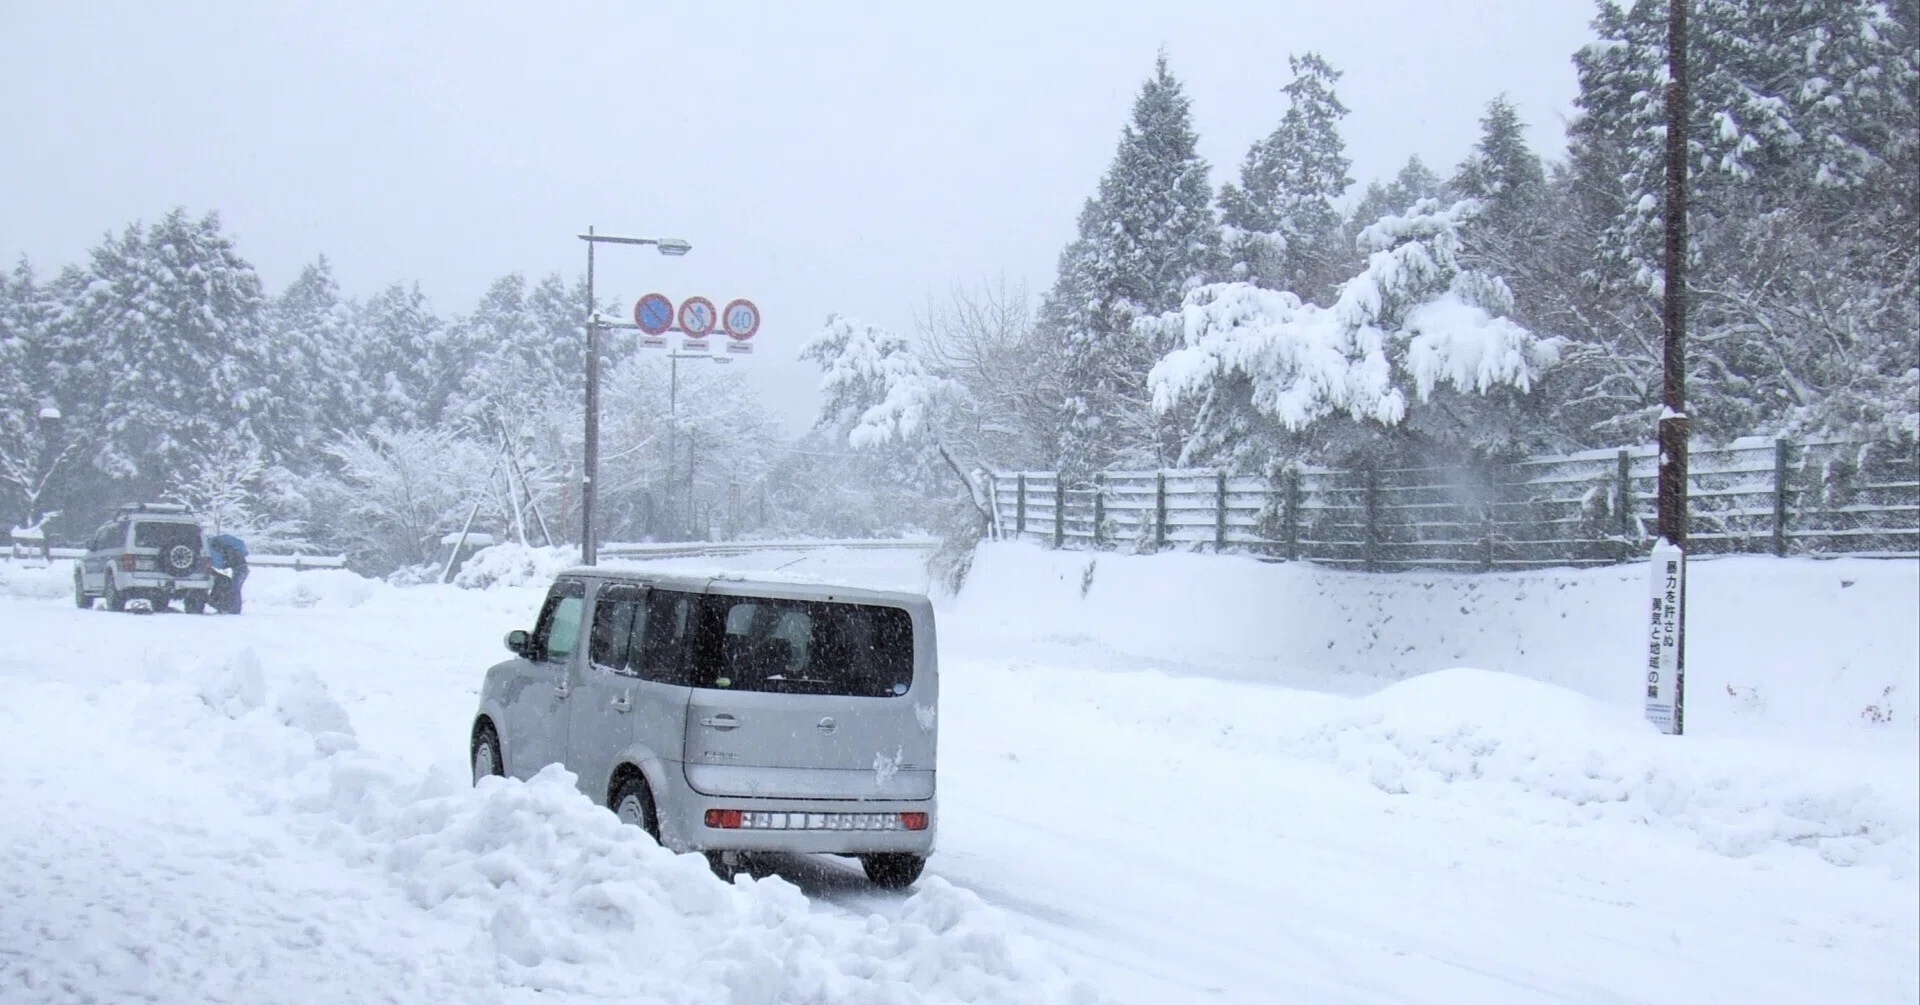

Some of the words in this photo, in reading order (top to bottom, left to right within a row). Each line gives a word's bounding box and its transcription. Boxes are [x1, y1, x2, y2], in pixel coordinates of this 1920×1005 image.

[732, 310, 752, 329] 40
[1663, 560, 1677, 647] 暴力を許さぬ
[1647, 598, 1662, 699] 勇気と地域の輪
